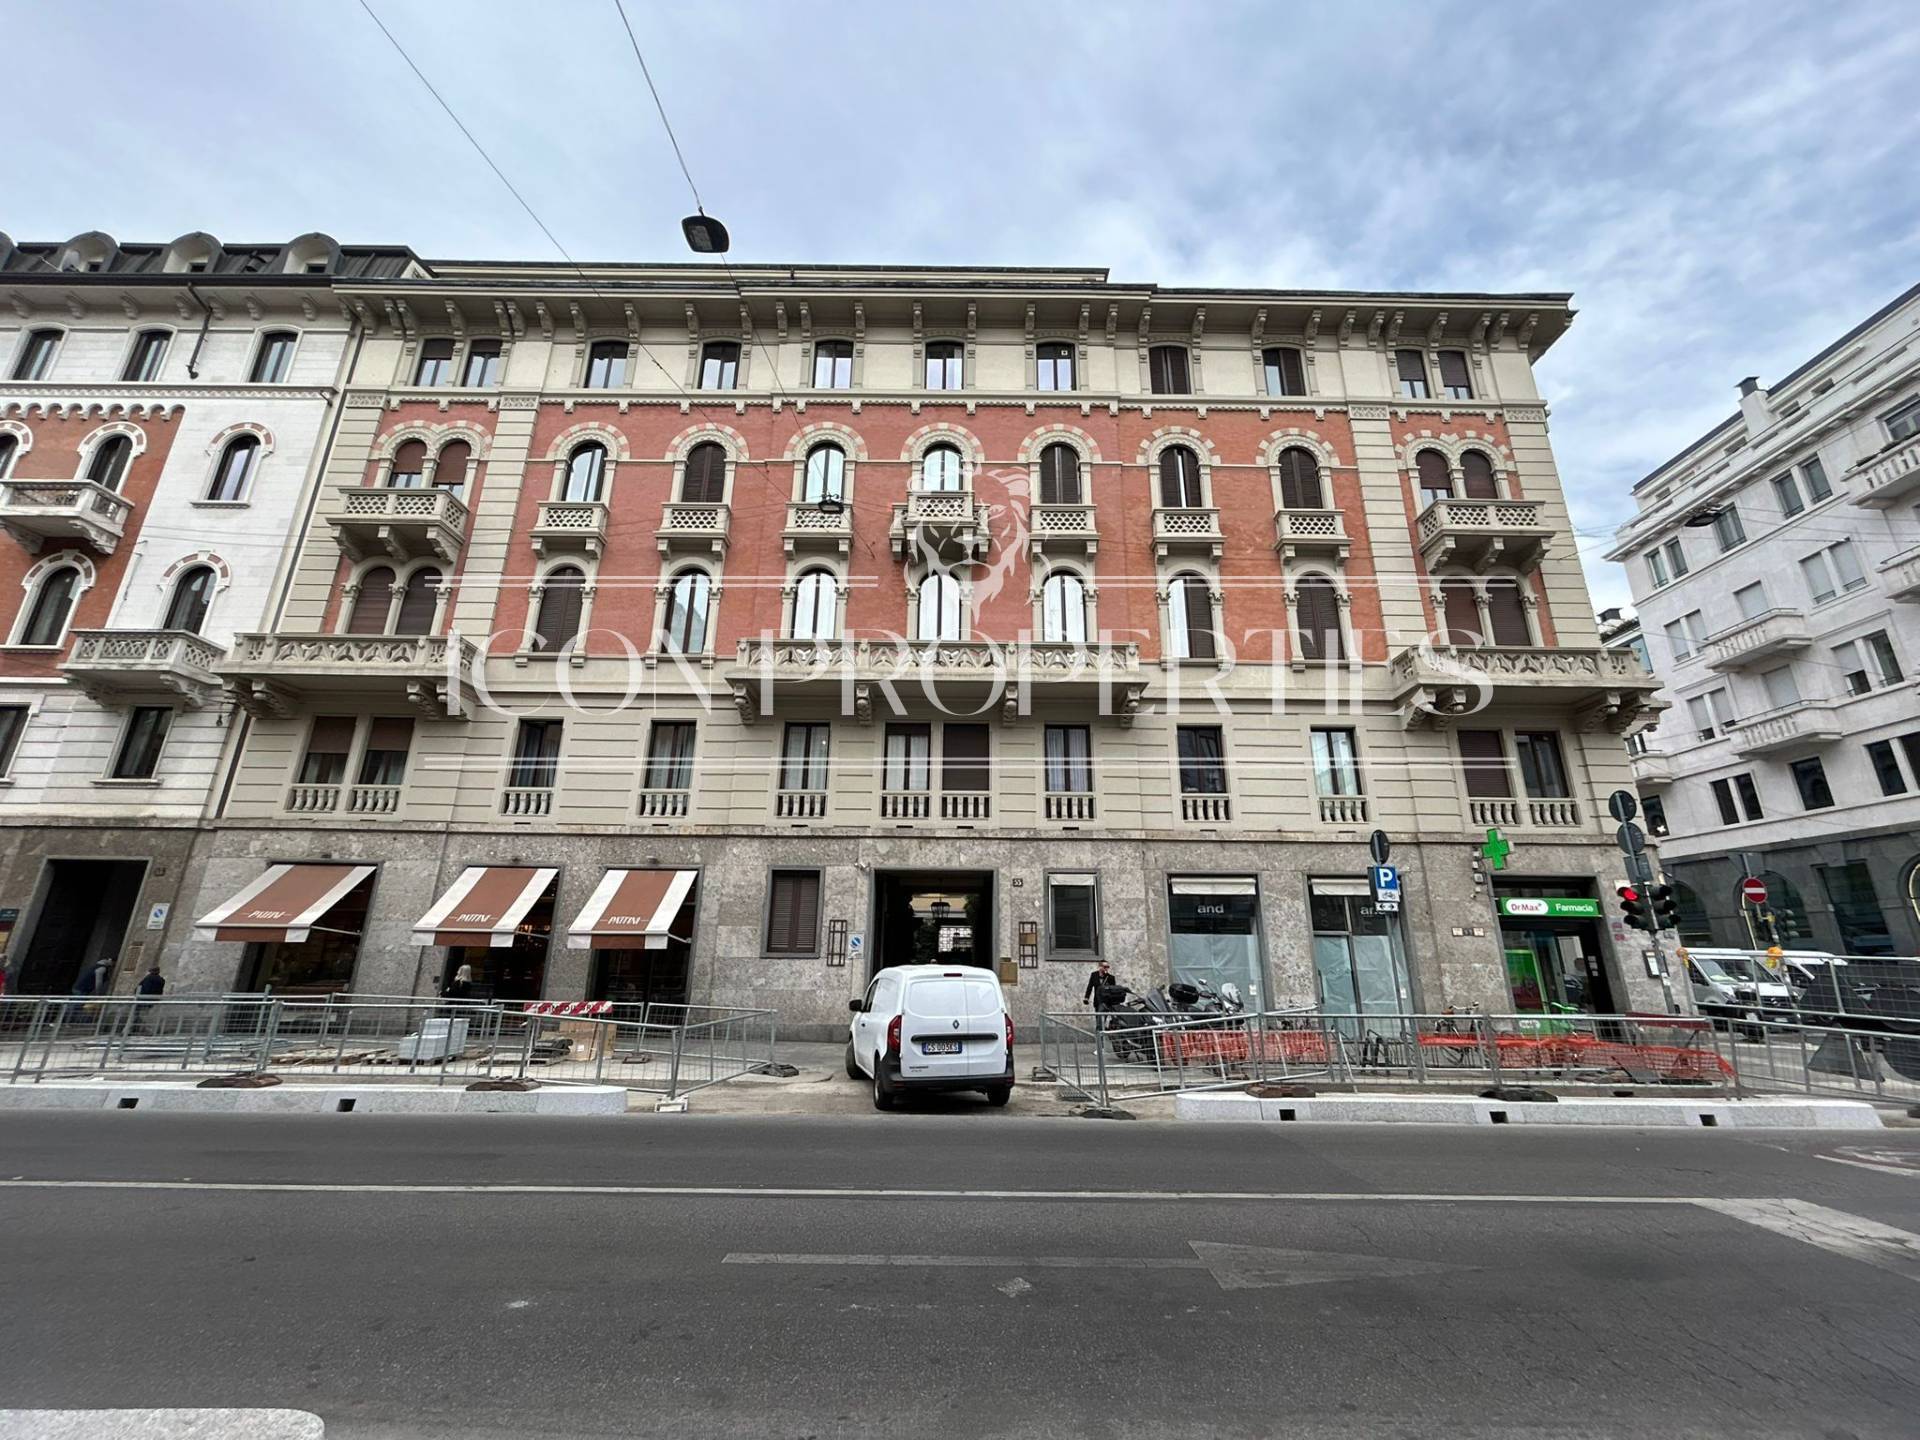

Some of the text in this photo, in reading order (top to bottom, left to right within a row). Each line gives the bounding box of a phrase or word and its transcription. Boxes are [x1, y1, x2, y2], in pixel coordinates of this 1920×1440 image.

[1378, 868, 1393, 888] P
[1197, 904, 1225, 914] and
[1555, 903, 1594, 912] Farmacia
